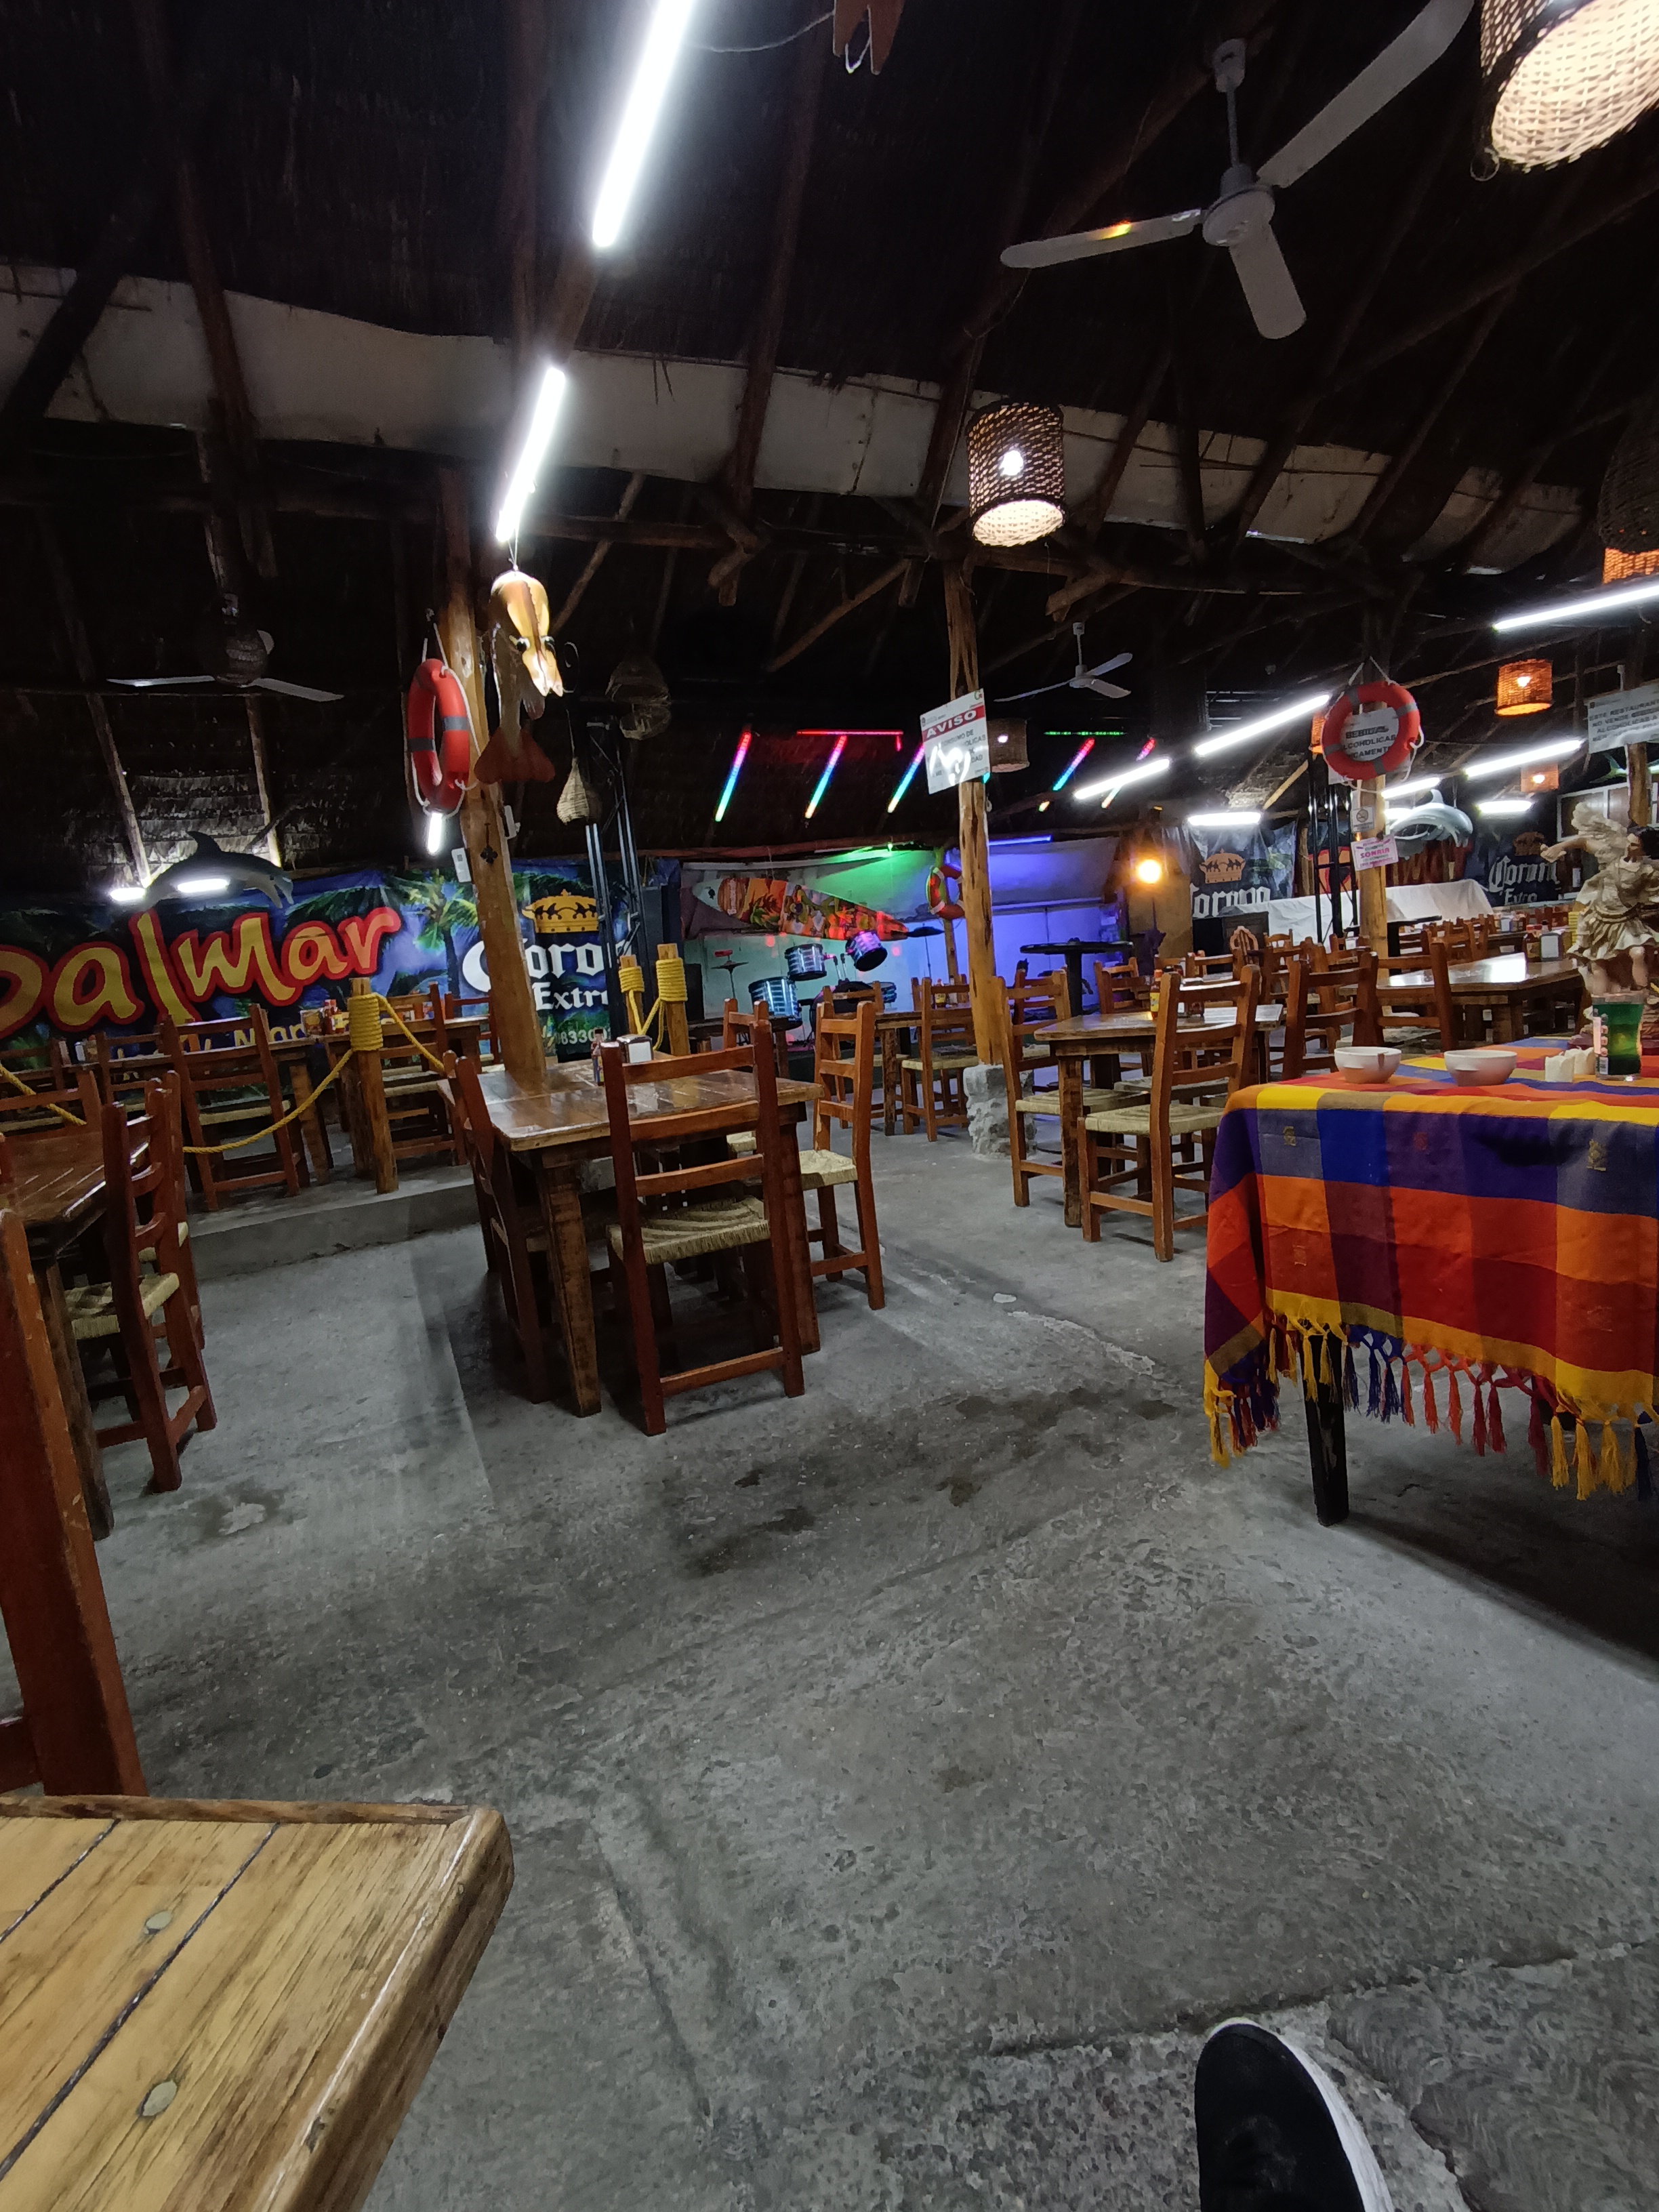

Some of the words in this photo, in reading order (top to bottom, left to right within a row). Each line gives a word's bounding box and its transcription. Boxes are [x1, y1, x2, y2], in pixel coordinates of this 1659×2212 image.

[926, 709, 977, 739] AVISO
[966, 729, 974, 737] DE
[1343, 734, 1396, 750] LCOHOLICAS
[1190, 882, 1271, 918] orona
[532, 981, 609, 1011] Extr
